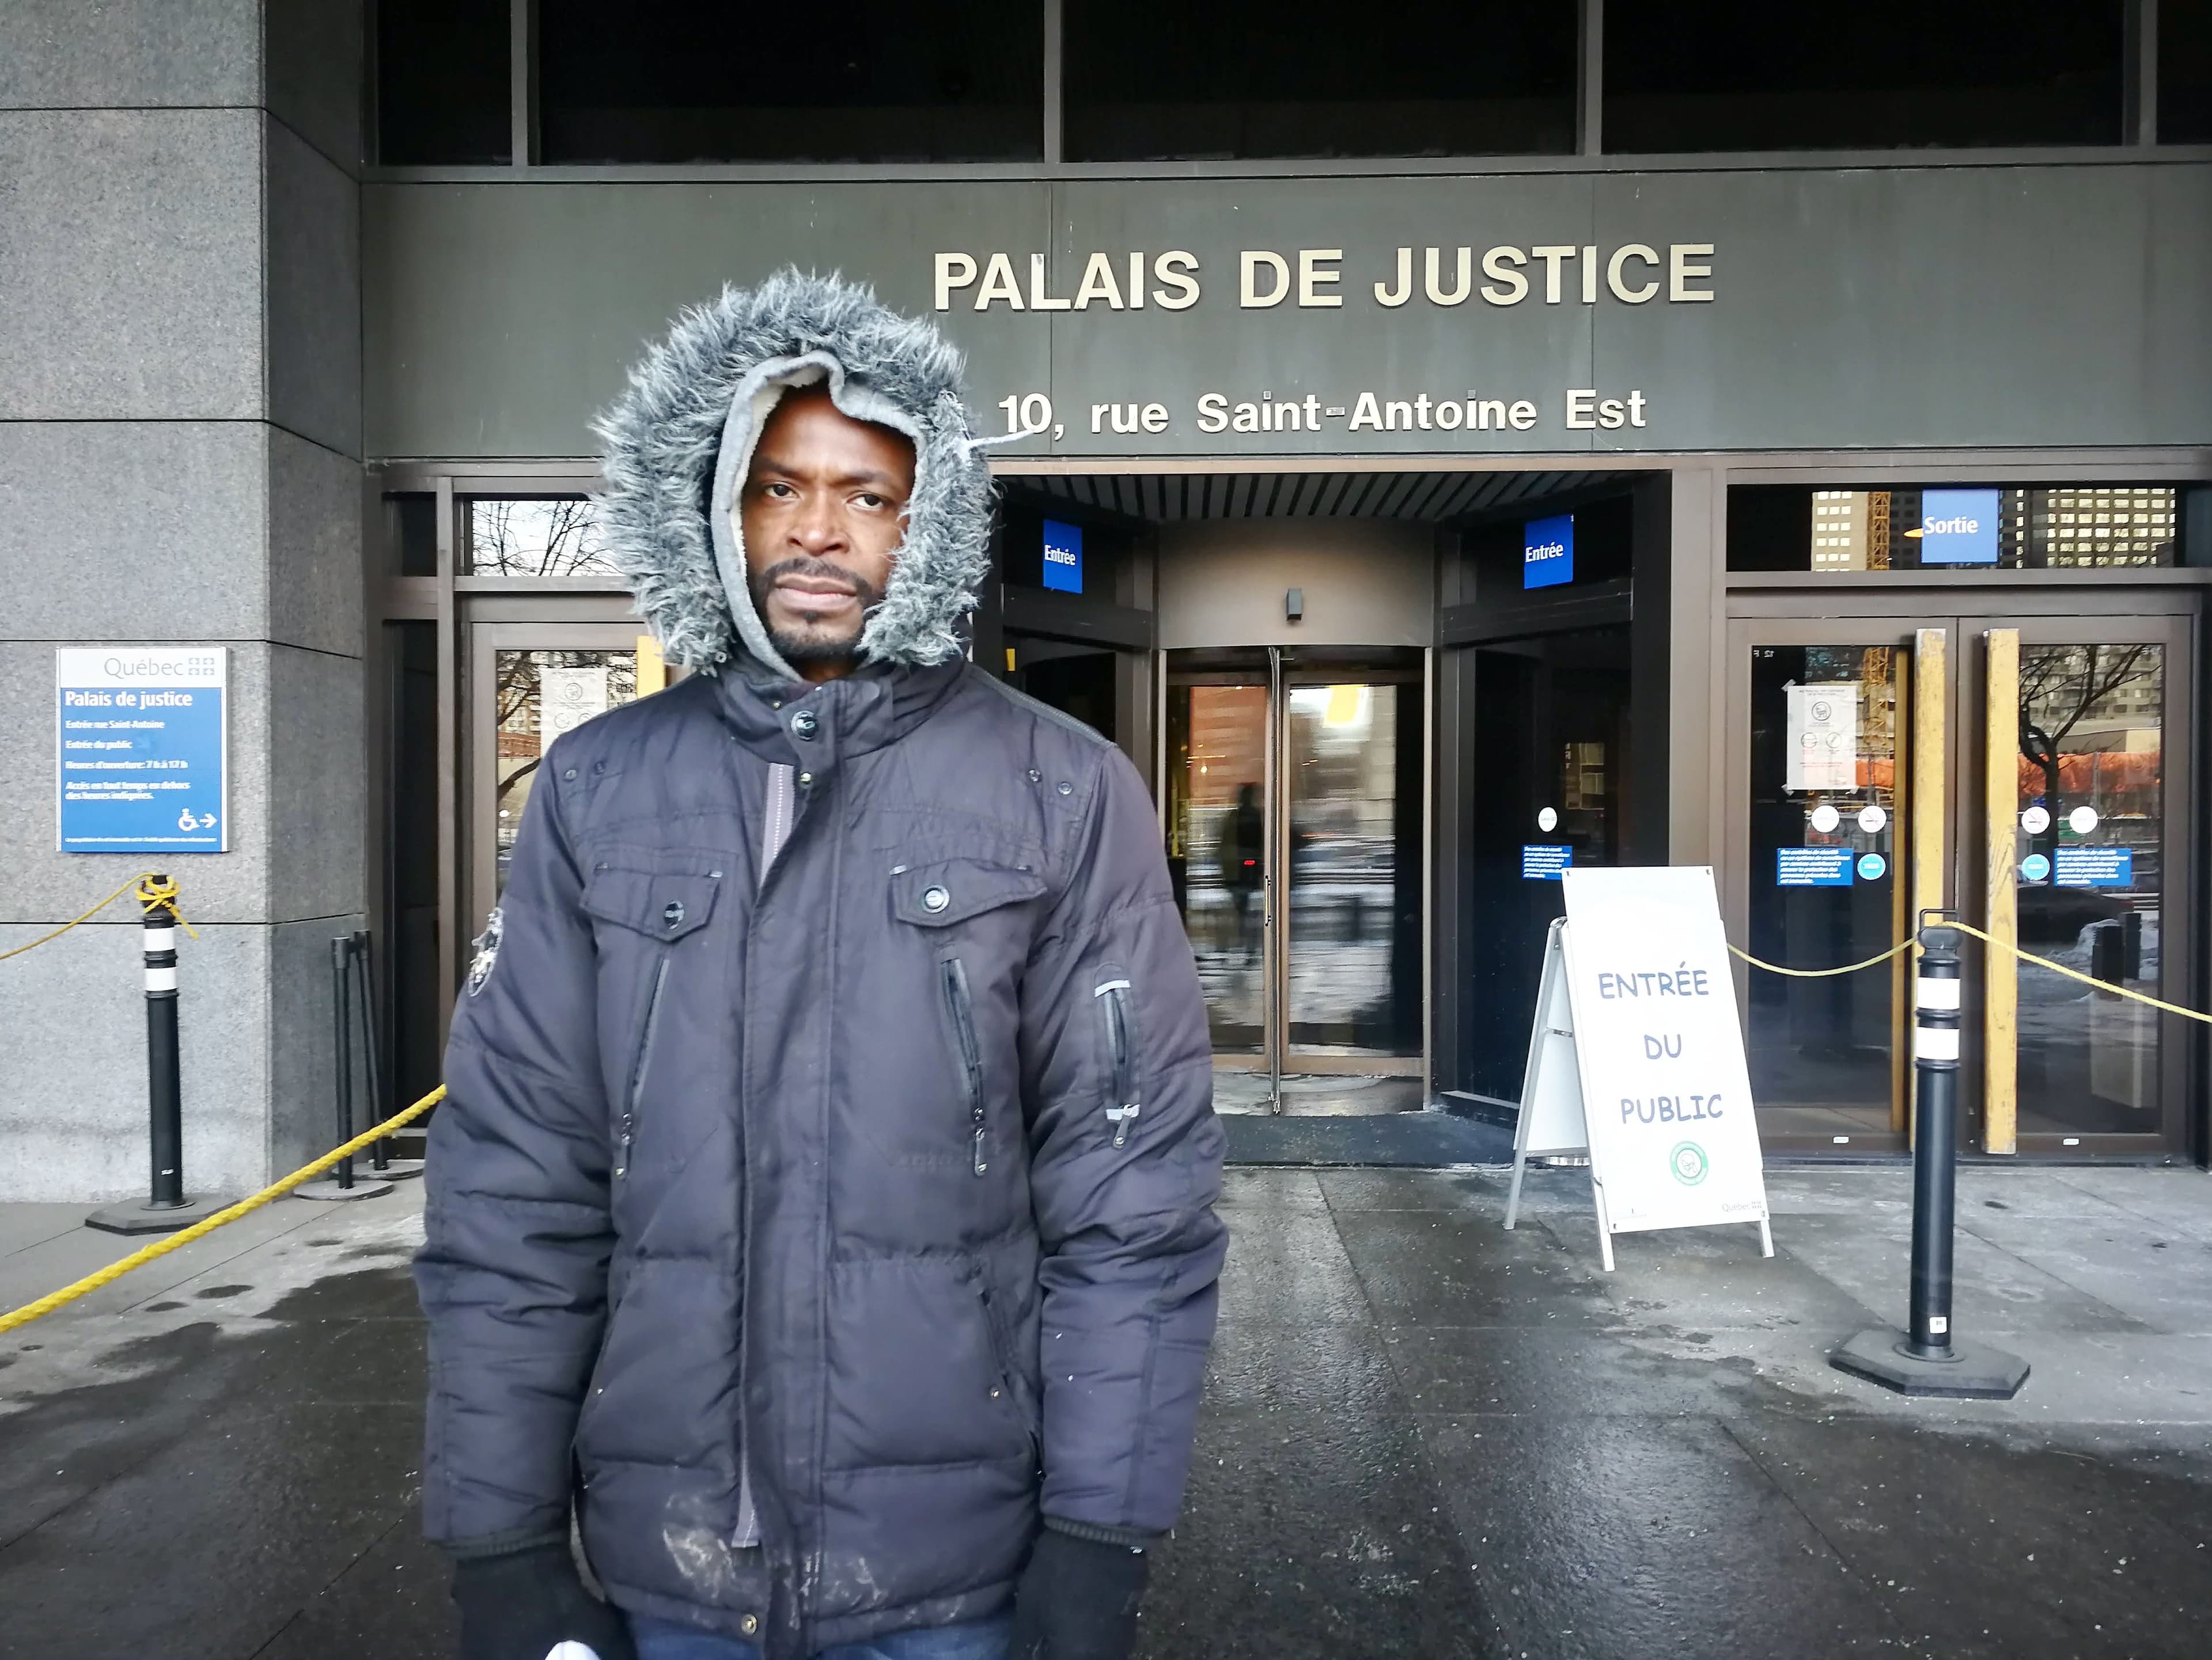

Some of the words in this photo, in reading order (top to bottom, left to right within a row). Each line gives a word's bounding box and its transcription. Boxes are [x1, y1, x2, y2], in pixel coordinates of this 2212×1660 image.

[934, 251, 1200, 311] PALAIS
[1239, 248, 1343, 308] DE
[1374, 243, 1715, 305] JUSTICE
[999, 392, 1065, 442] 10,
[1091, 403, 1169, 434] rue
[1196, 389, 1537, 433] Saint-Antoine
[1566, 388, 1646, 430] Est
[1924, 516, 1979, 534] Sortie
[1044, 544, 1076, 566] Entrée
[1525, 541, 1564, 563] Entrée
[104, 657, 184, 679] Québec
[65, 691, 112, 706] Palais
[115, 691, 137, 706] de
[139, 691, 193, 710] justice
[1598, 960, 1709, 999] ENTRÉE
[1643, 1033, 1682, 1060] DU
[1620, 1093, 1724, 1125] PUBLIC
